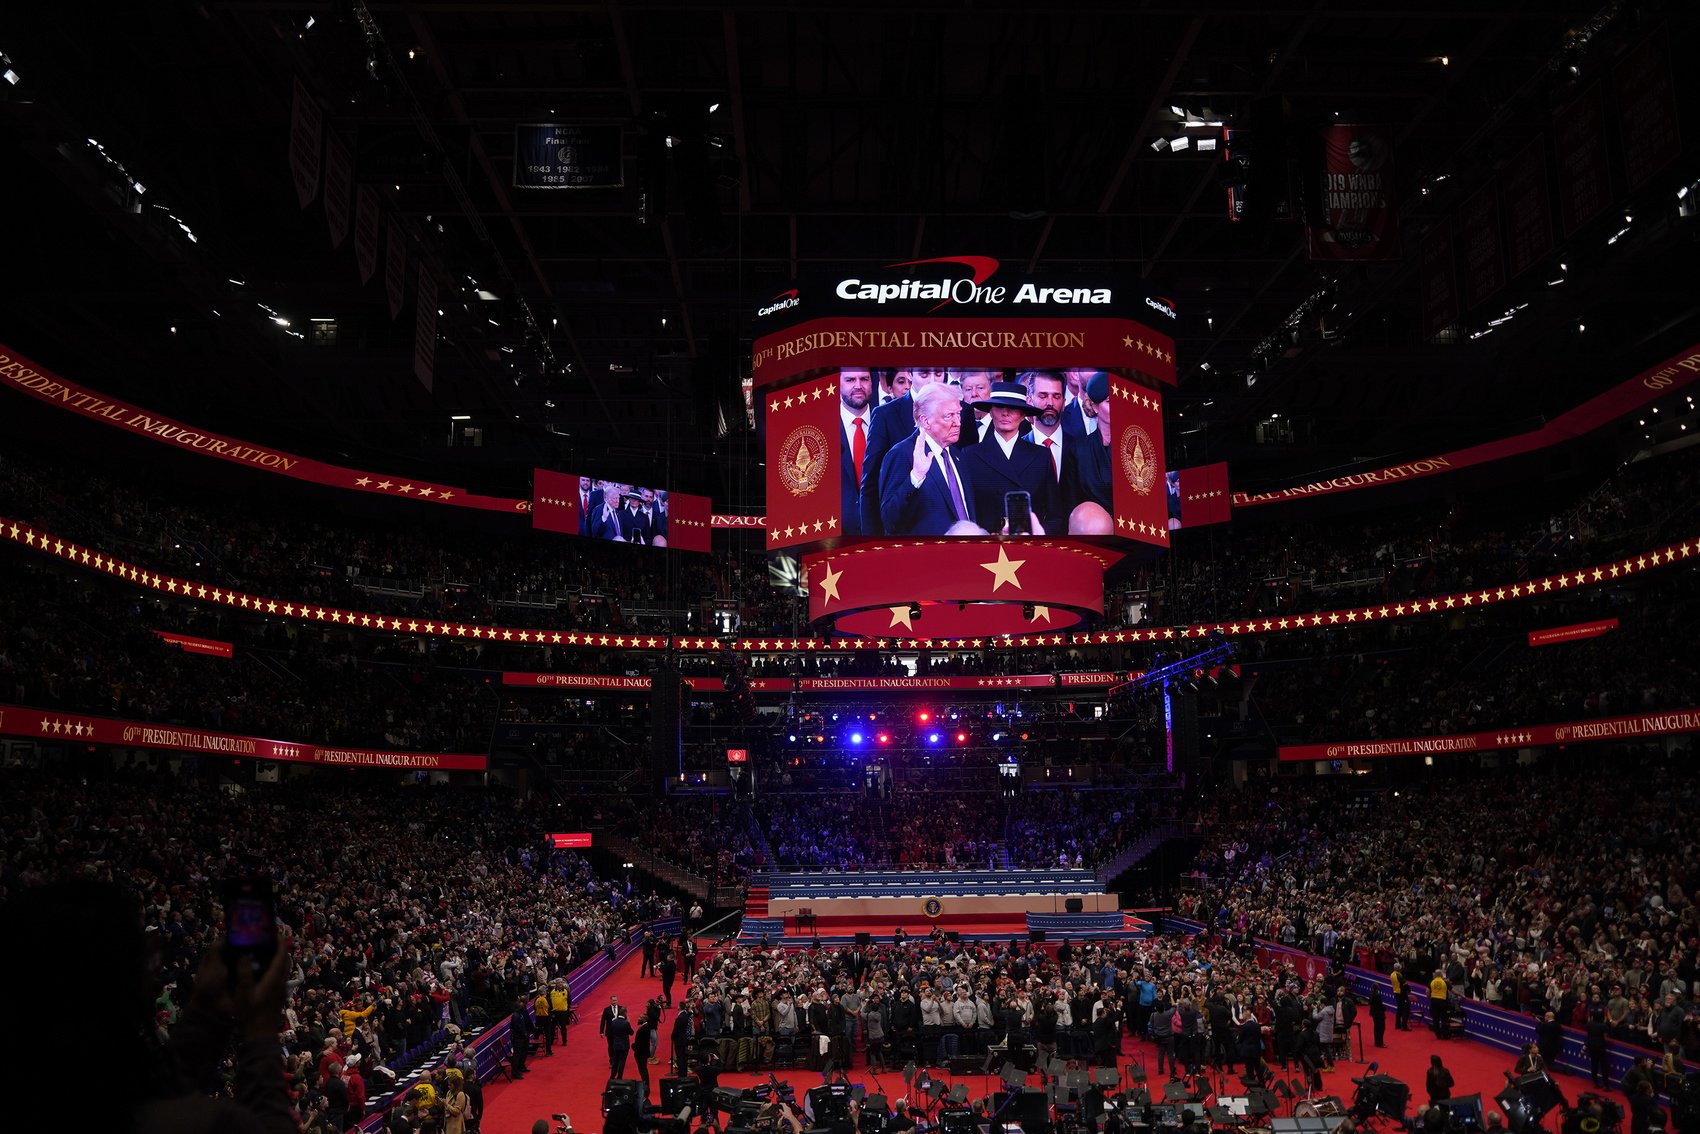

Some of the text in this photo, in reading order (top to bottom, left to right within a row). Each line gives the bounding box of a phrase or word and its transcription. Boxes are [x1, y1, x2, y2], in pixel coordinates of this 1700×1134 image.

[1013, 283, 1112, 304] Arena
[777, 331, 915, 361] PRESIDENTIAL
[920, 331, 1085, 348] INAUGURATION
[125, 414, 299, 471] INAUGURATION
[1282, 456, 1451, 497] INAUGURATION
[556, 676, 621, 687] PRESIDENTIAL
[812, 679, 878, 688] PRESIDENTIAL
[880, 678, 951, 687] INAUGURATION
[1572, 719, 1641, 739] PRESIDENTIAL
[123, 725, 256, 754] 60TH PRESIDENTIAL INAUGURATION
[1327, 737, 1477, 757] 60TH PRESIDENTIAL INAUGURATION
[324, 750, 375, 764] PRESIDENTIAL
[375, 754, 439, 766] INAUGURATION
